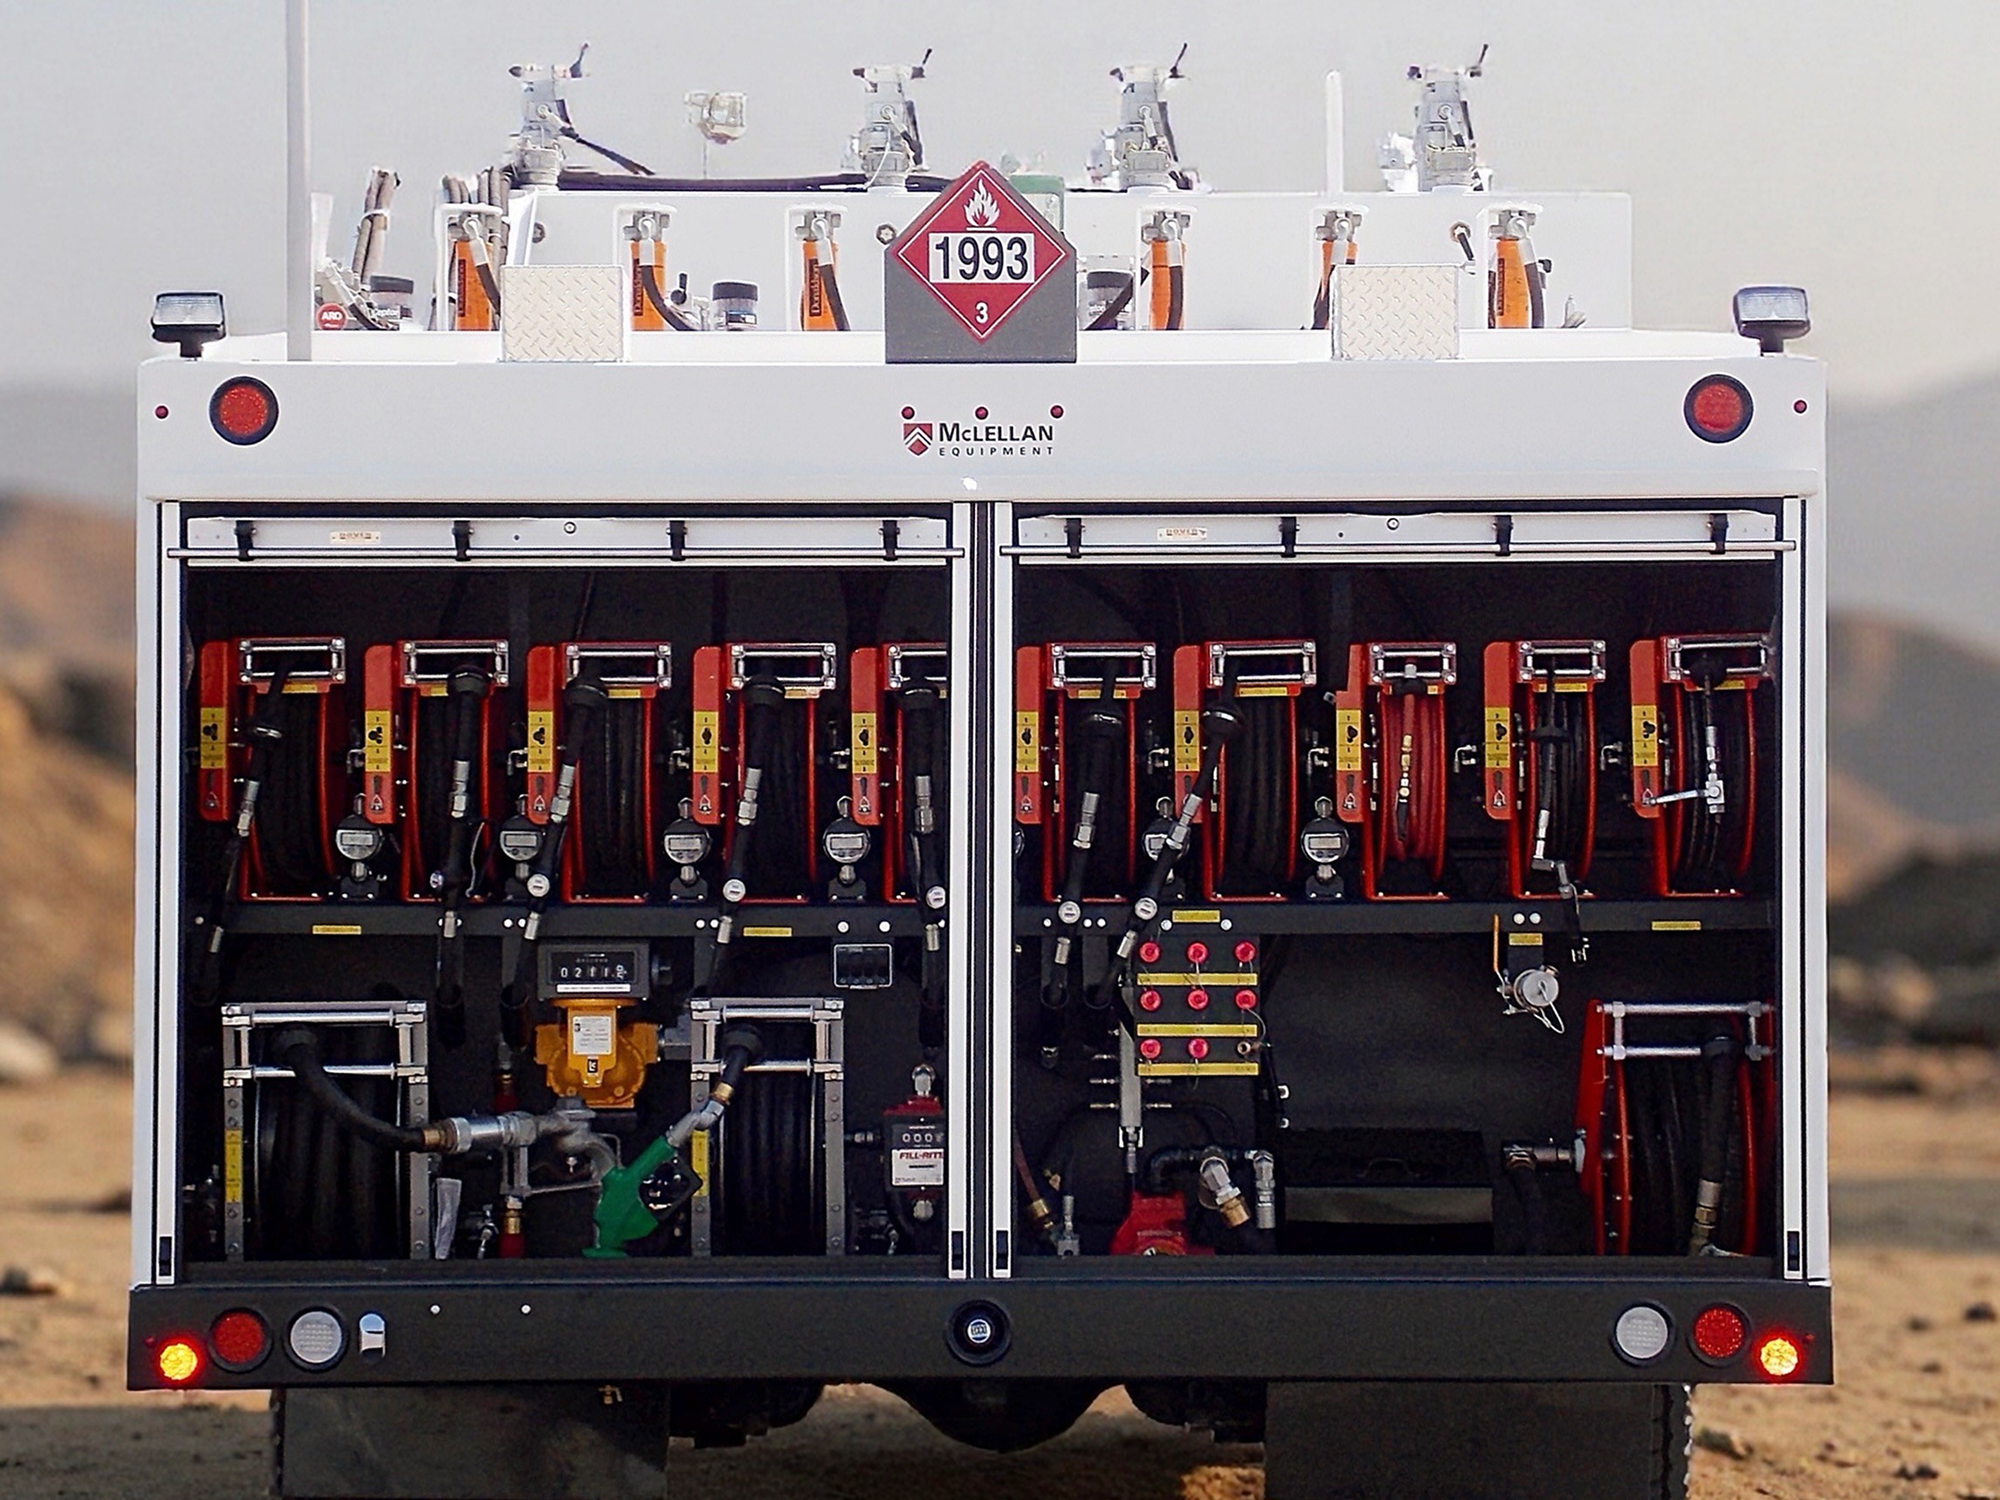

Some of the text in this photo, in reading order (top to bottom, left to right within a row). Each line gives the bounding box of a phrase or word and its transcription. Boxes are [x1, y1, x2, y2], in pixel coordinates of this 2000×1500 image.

[935, 235, 1028, 281] 1993
[975, 302, 988, 324] 3
[939, 423, 1053, 442] McLELLAN
[939, 447, 1053, 457] EQUIPMENT
